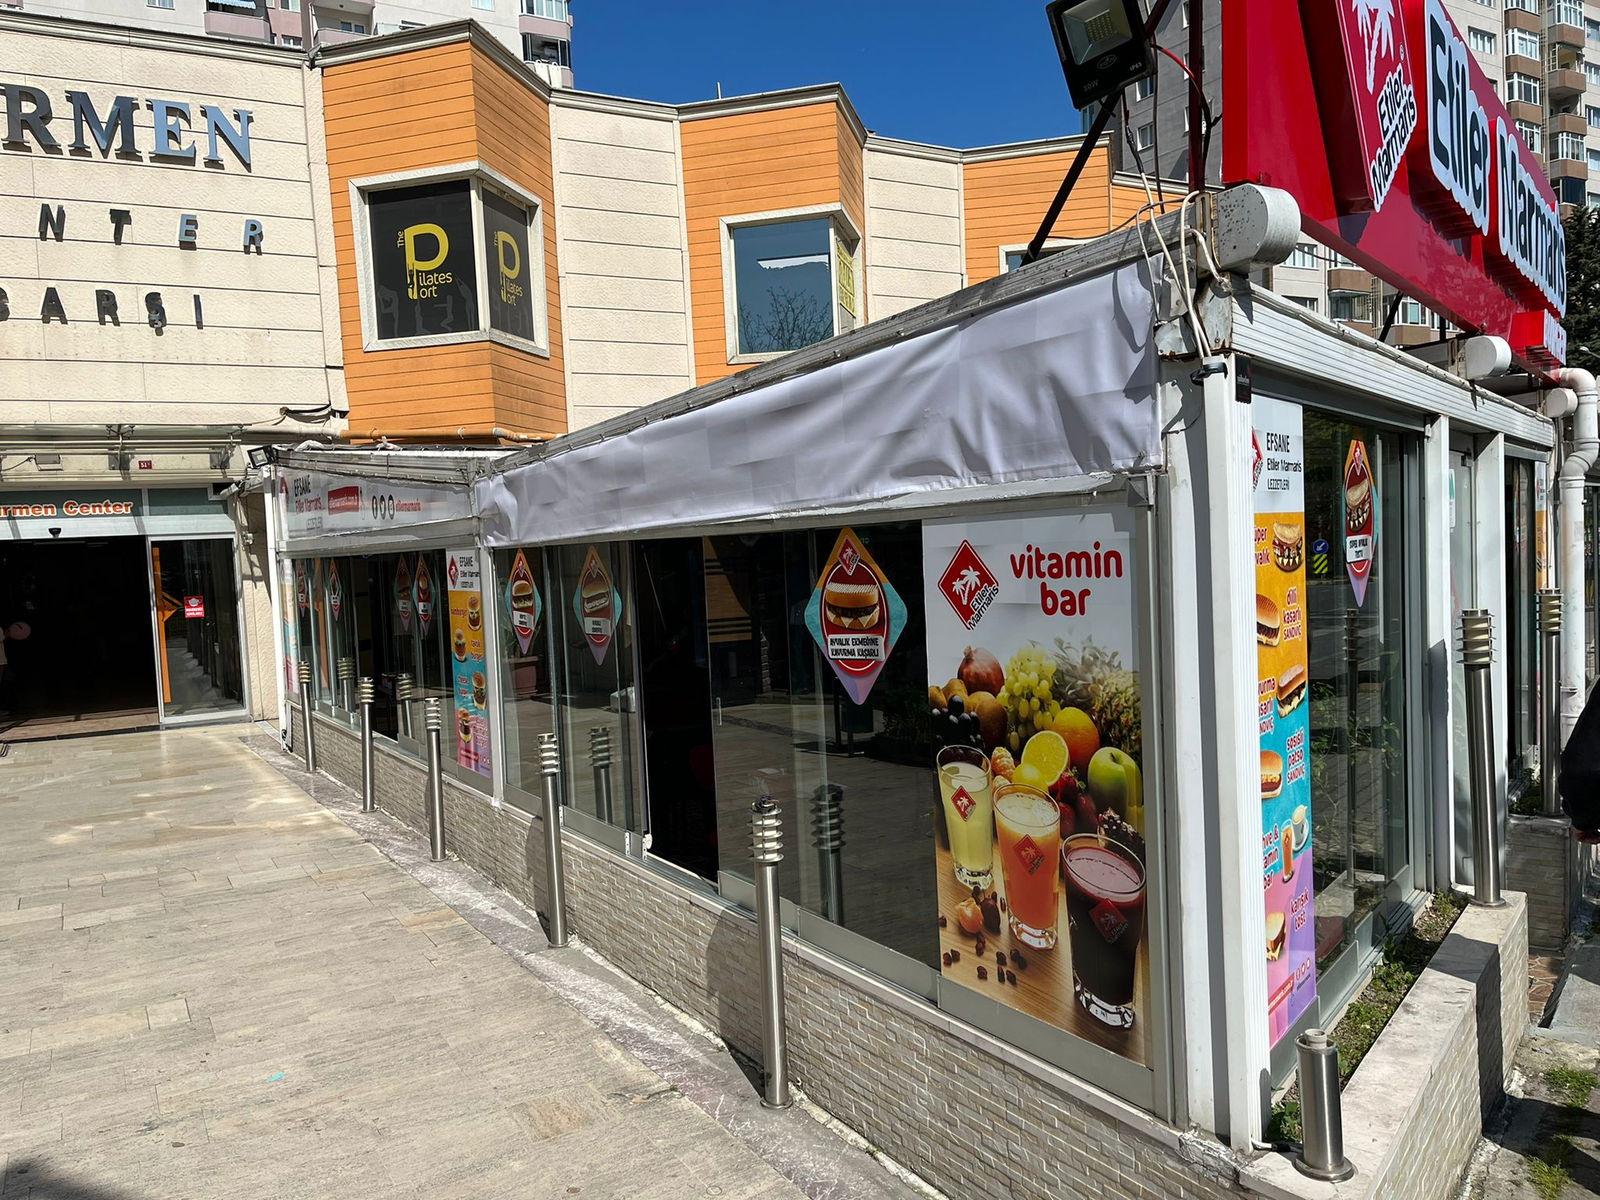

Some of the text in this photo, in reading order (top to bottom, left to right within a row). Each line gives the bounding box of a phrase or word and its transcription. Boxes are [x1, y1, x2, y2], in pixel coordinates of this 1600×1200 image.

[1377, 66, 1405, 141] Etiler
[1371, 86, 1416, 207] Marmaris
[1428, 8, 1566, 308] Etiler Marmaris
[1266, 432, 1290, 453] EFSANE
[1267, 458, 1280, 471] Etiler
[63, 499, 134, 516] Center
[1010, 541, 1124, 580] vitamin
[967, 585, 999, 630] Marmaris
[969, 584, 990, 611] Etiler
[1040, 582, 1092, 617] bar
